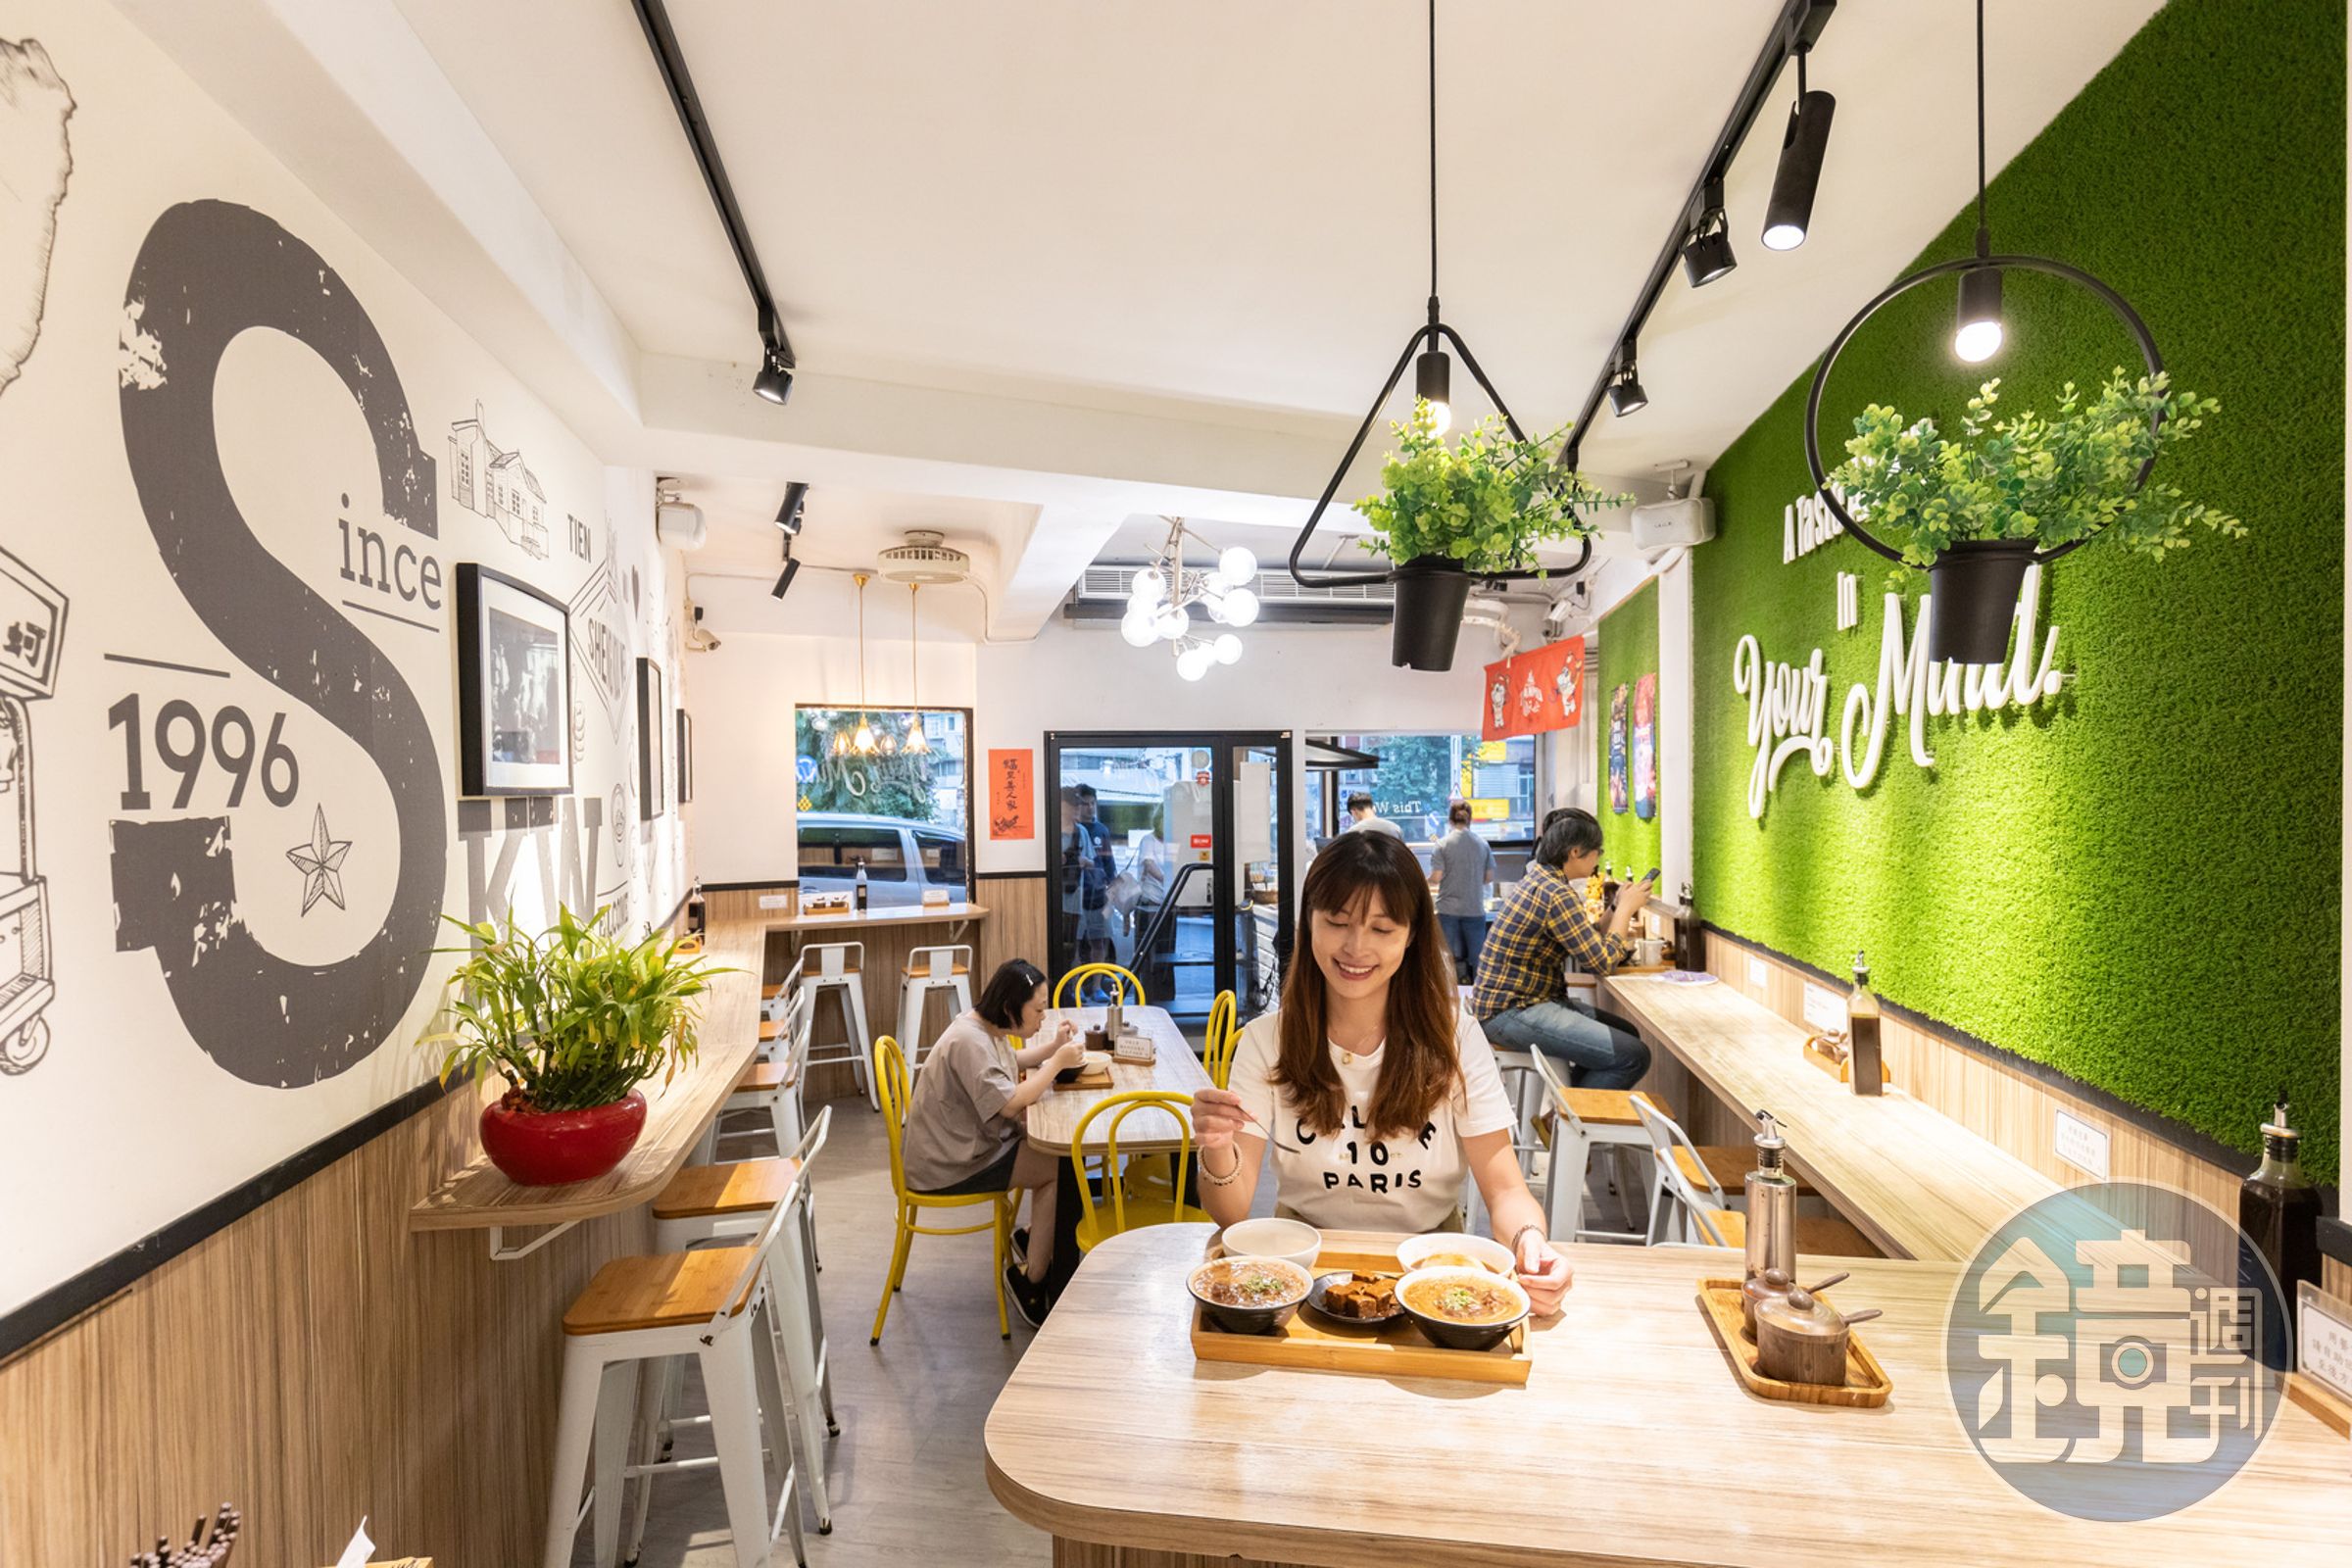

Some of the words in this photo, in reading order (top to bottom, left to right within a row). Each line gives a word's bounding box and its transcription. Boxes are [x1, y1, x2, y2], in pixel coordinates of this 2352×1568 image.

[566, 513, 592, 564] TIEN
[107, 692, 299, 811] 1996
[1734, 635, 1834, 818] Your
[1346, 1141, 1389, 1166] 10
[1323, 1169, 1422, 1194] PARIS
